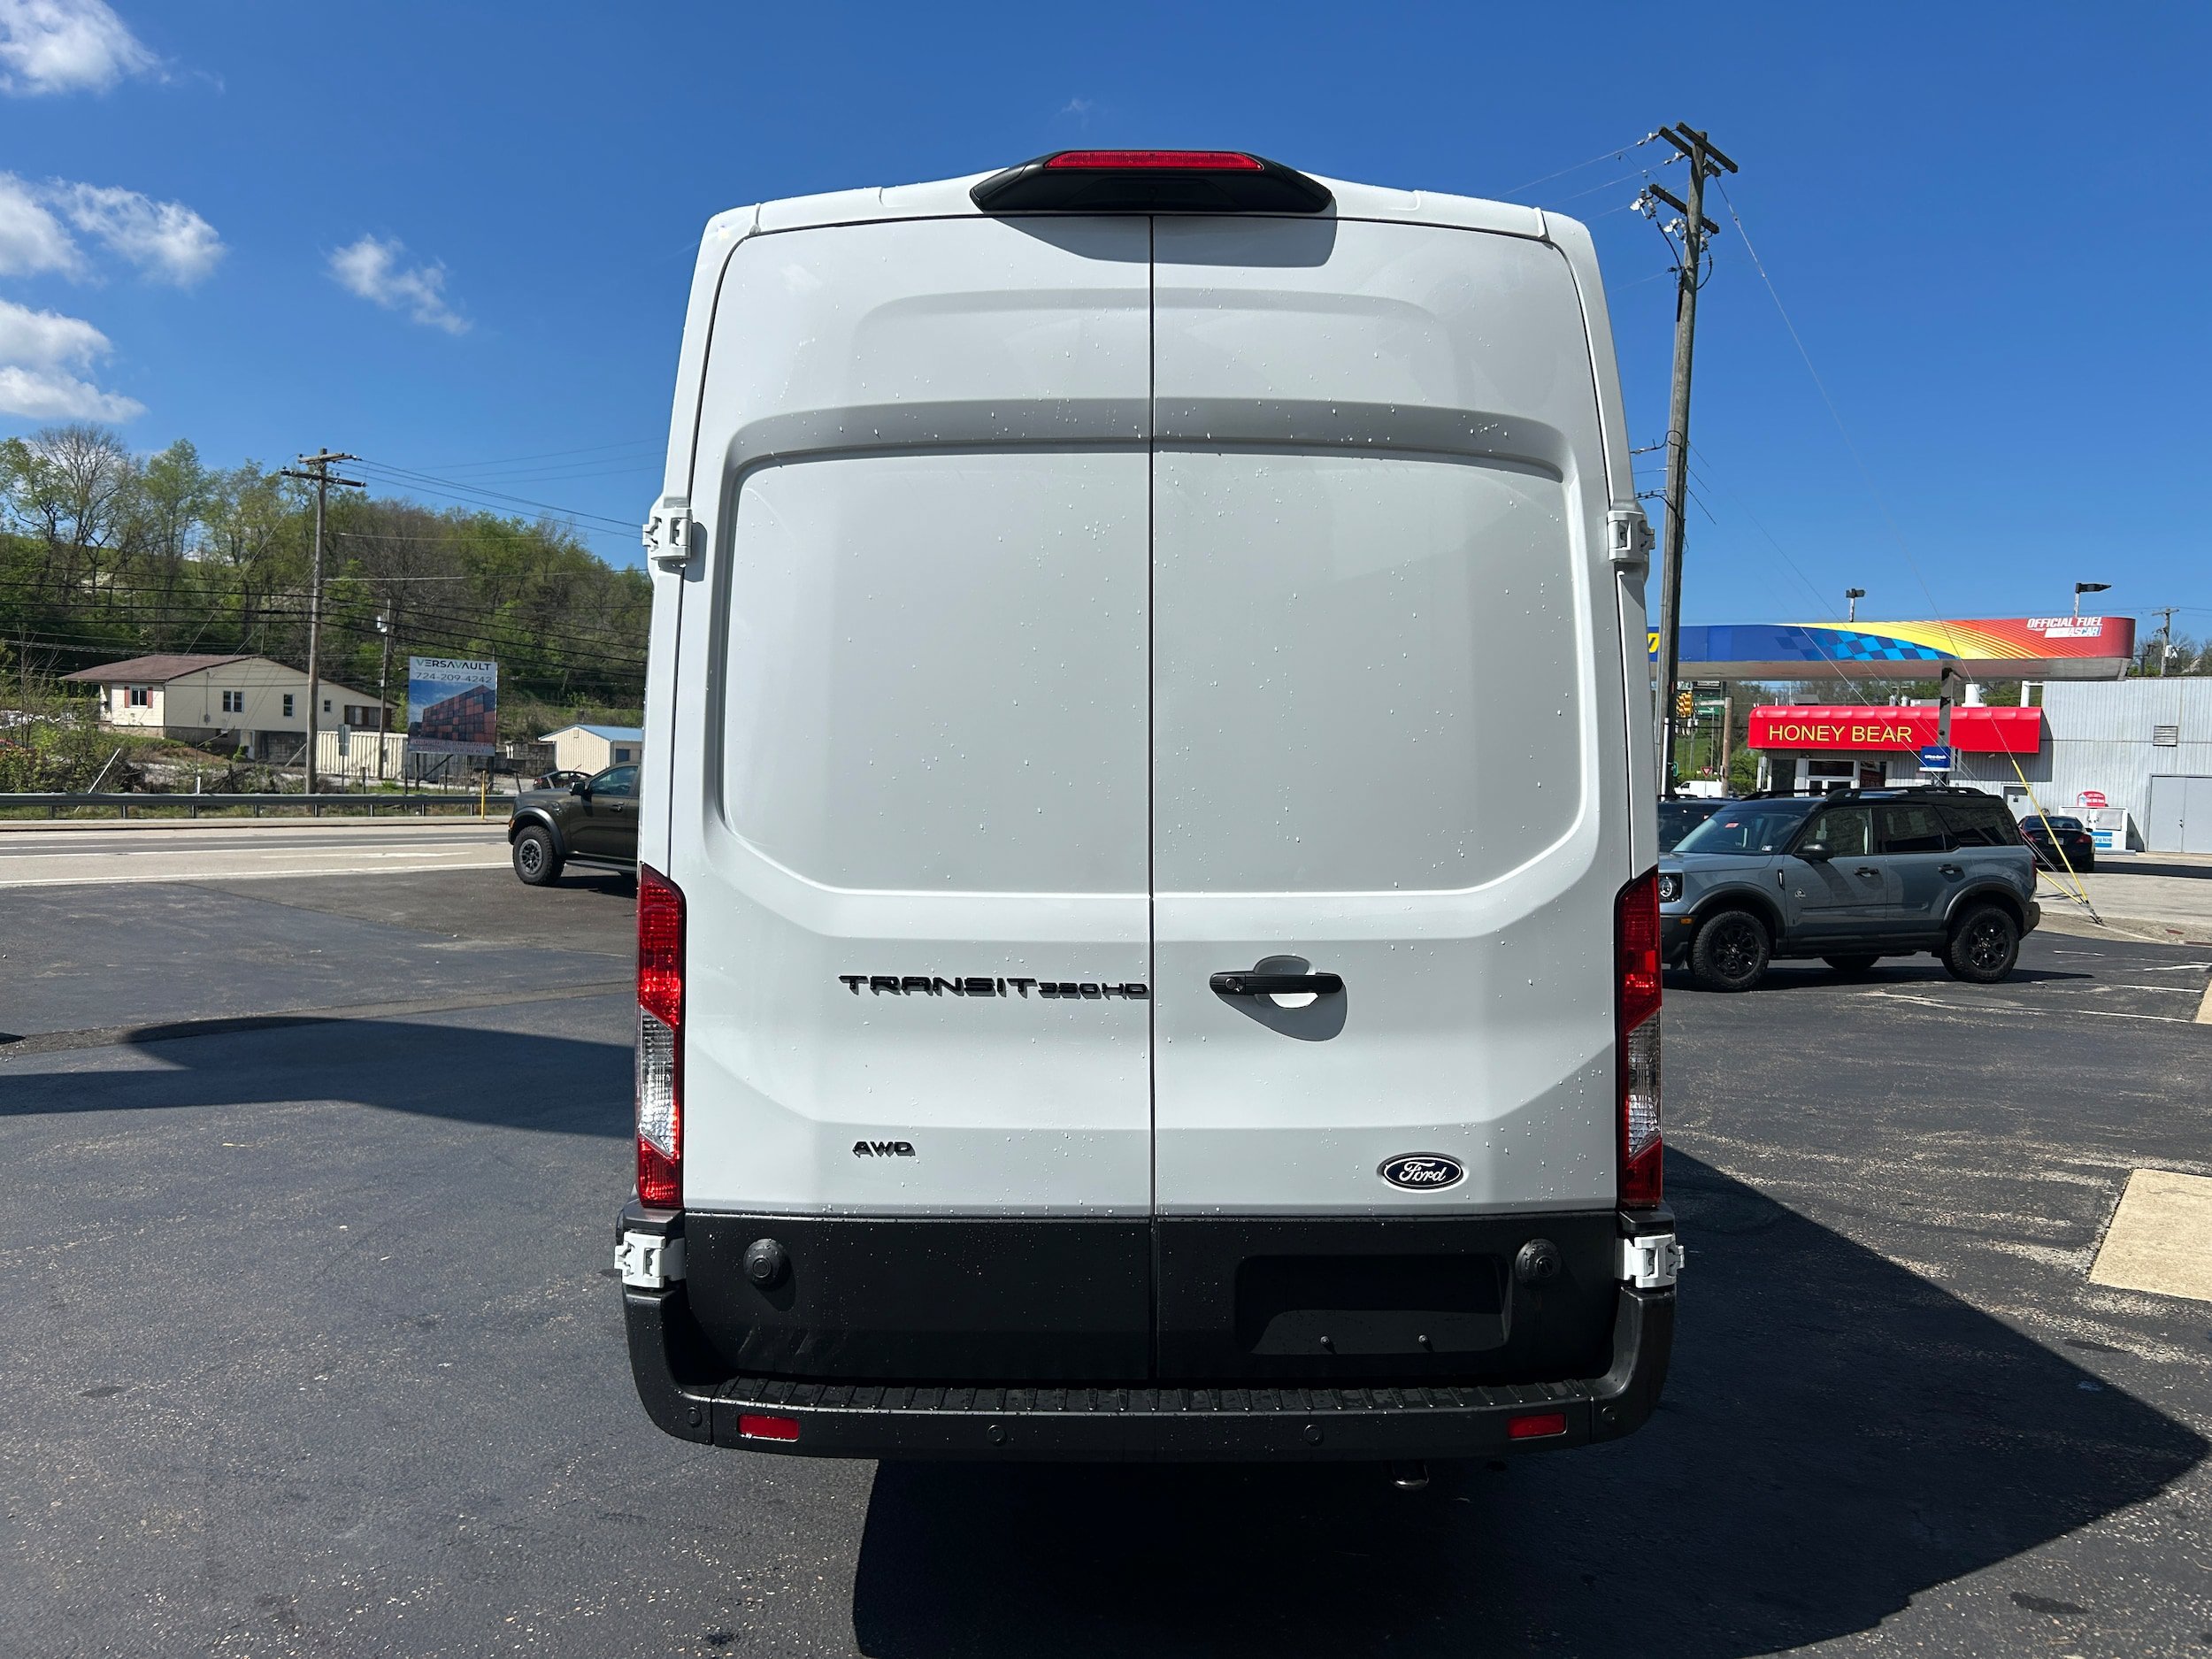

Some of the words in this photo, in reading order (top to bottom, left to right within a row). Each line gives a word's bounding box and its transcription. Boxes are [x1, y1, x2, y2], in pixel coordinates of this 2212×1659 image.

[2026, 618, 2074, 628] OFFICIAL
[2075, 617, 2103, 626] FUEL
[416, 658, 492, 671] VERSAVAULT
[416, 672, 492, 683] 724-209-4242
[1769, 725, 1846, 742] HONEY
[1851, 726, 1913, 743] BEAR
[839, 975, 1037, 997] TRANSIT
[852, 1141, 916, 1158] AWD
[1399, 1161, 1448, 1182] Ford
